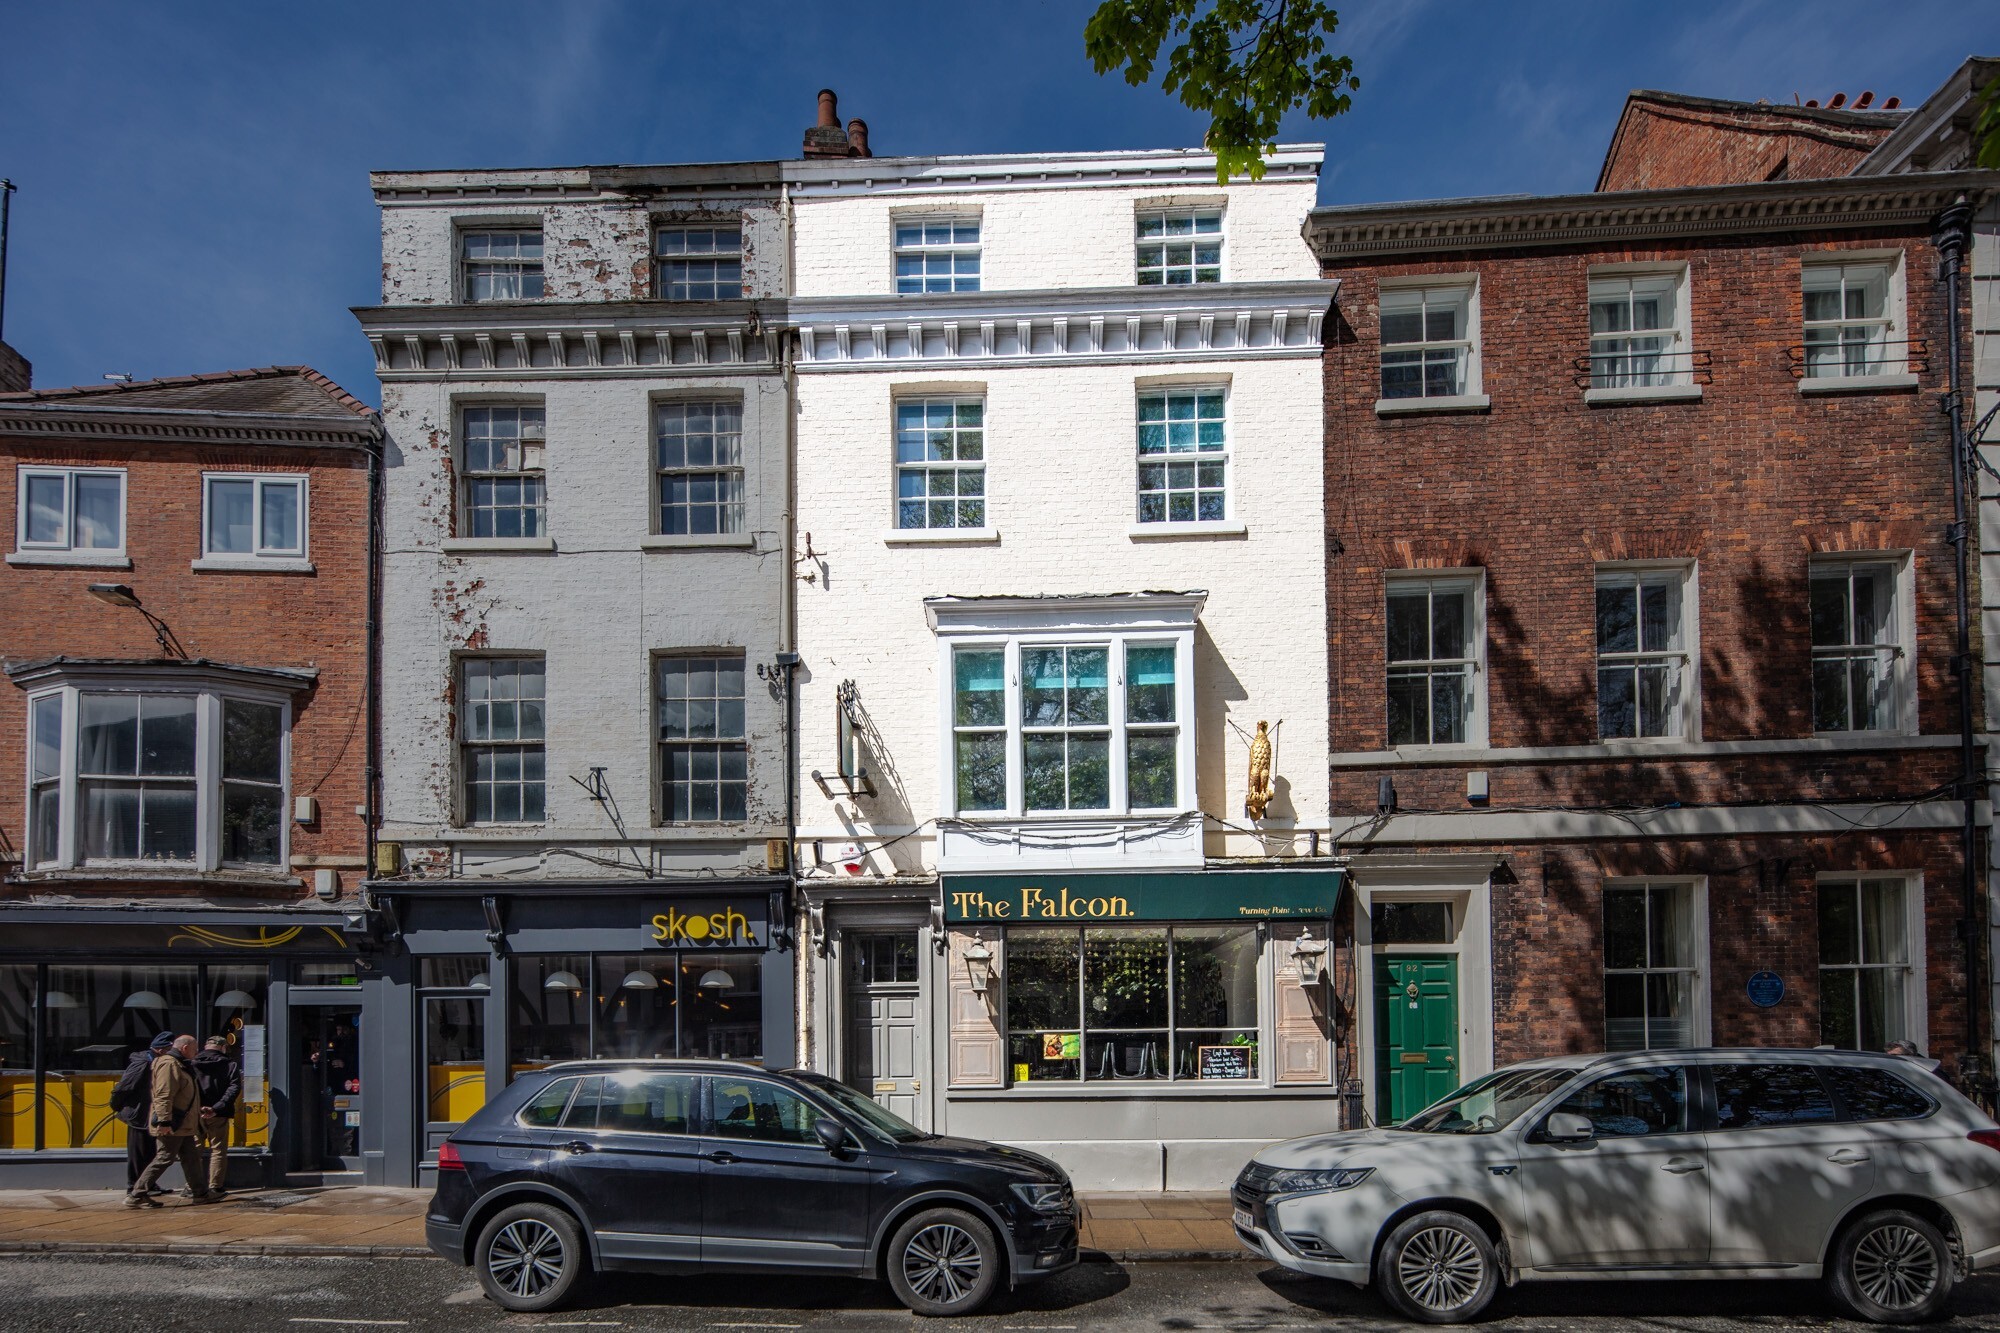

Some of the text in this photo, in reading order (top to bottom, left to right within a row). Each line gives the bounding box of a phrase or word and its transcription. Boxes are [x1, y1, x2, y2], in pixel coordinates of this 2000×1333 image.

[951, 887, 1135, 918] The Falcon.
[1240, 906, 1270, 916] Turning
[651, 905, 754, 940] skosh.
